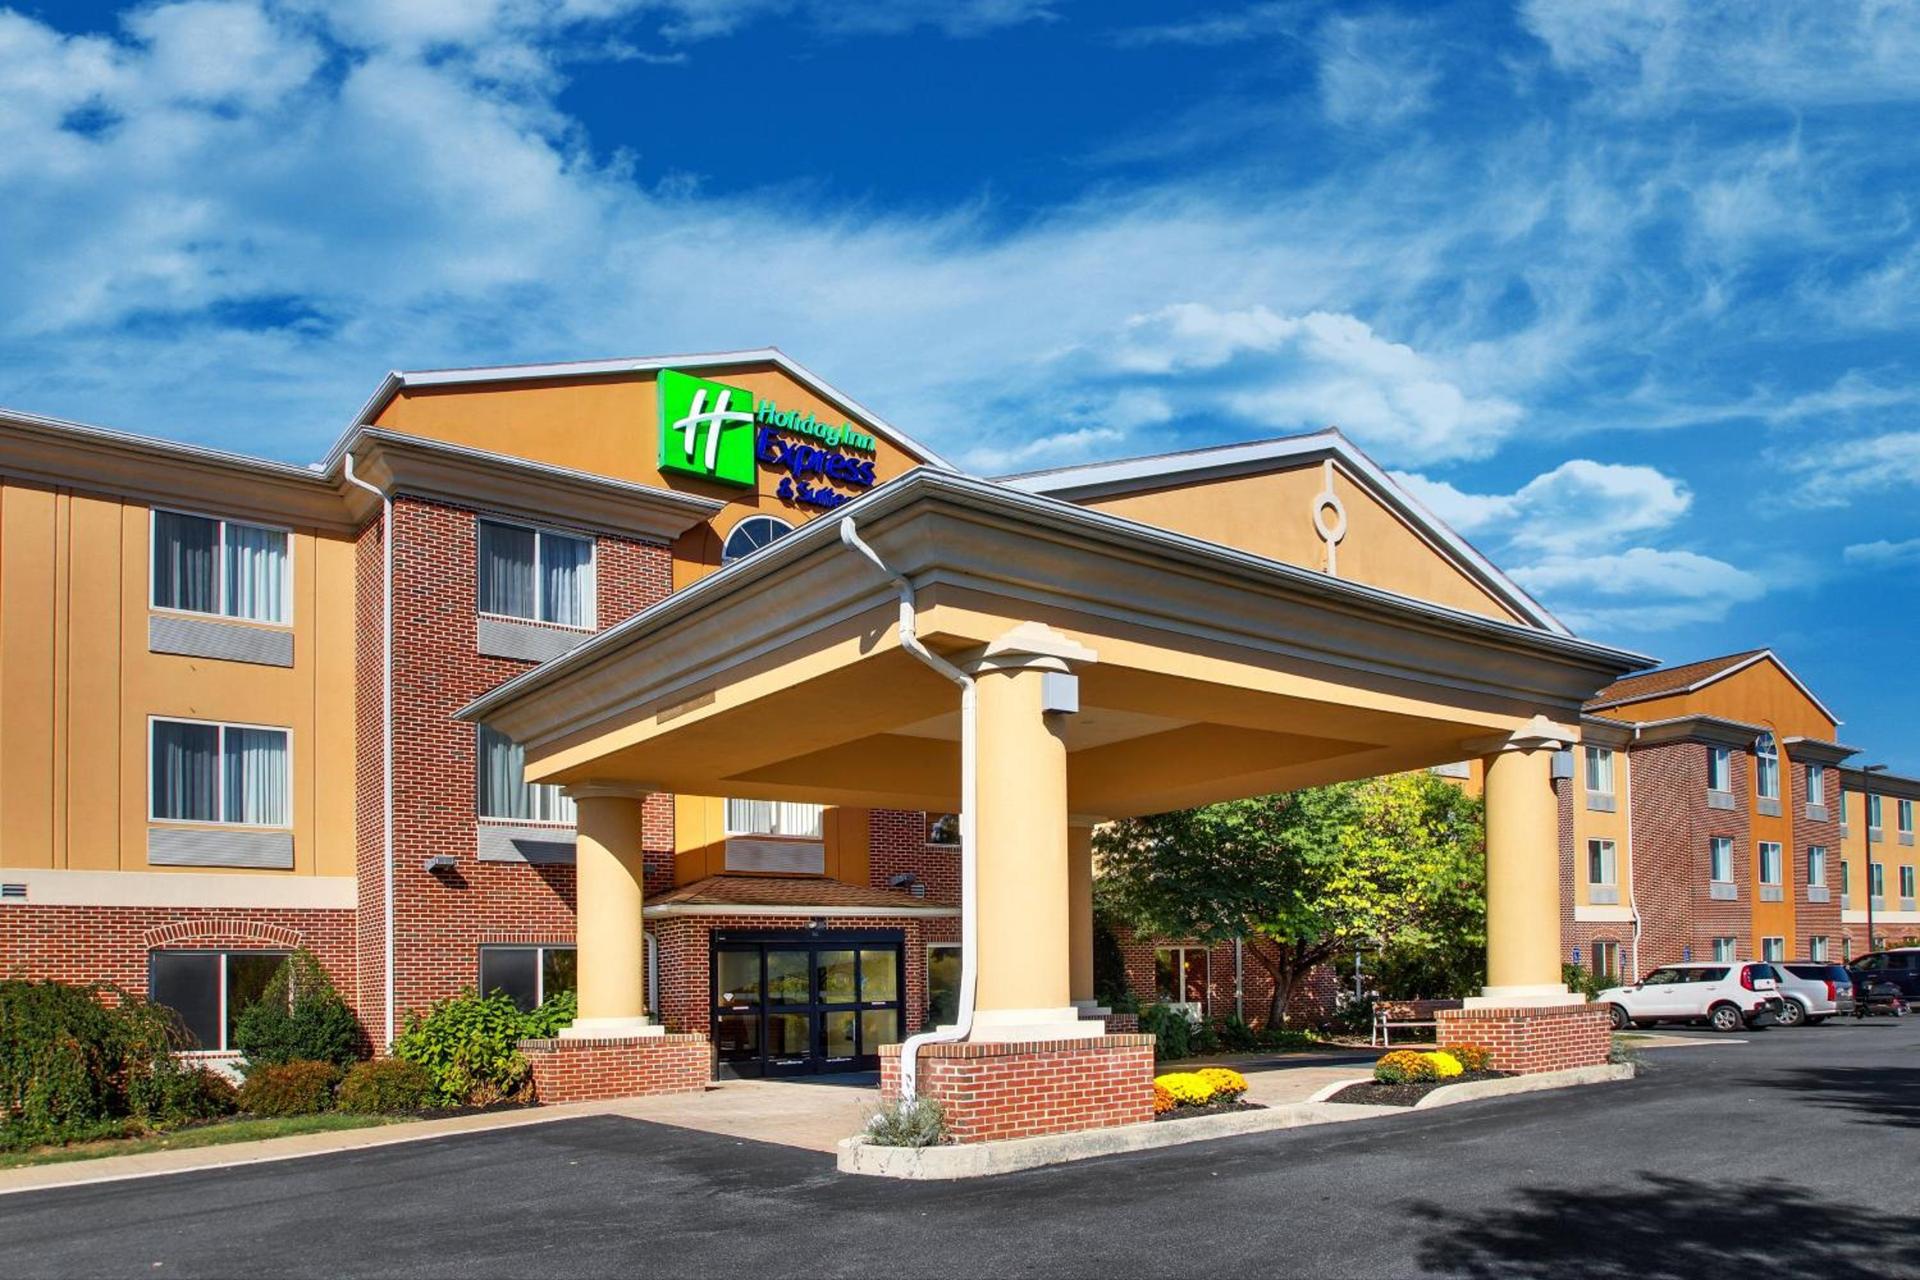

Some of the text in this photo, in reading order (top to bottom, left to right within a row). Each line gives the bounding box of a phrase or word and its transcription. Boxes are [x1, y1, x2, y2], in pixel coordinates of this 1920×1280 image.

[757, 399, 876, 451] Holiday Inn
[757, 426, 876, 487] Express
[776, 477, 794, 501] &
